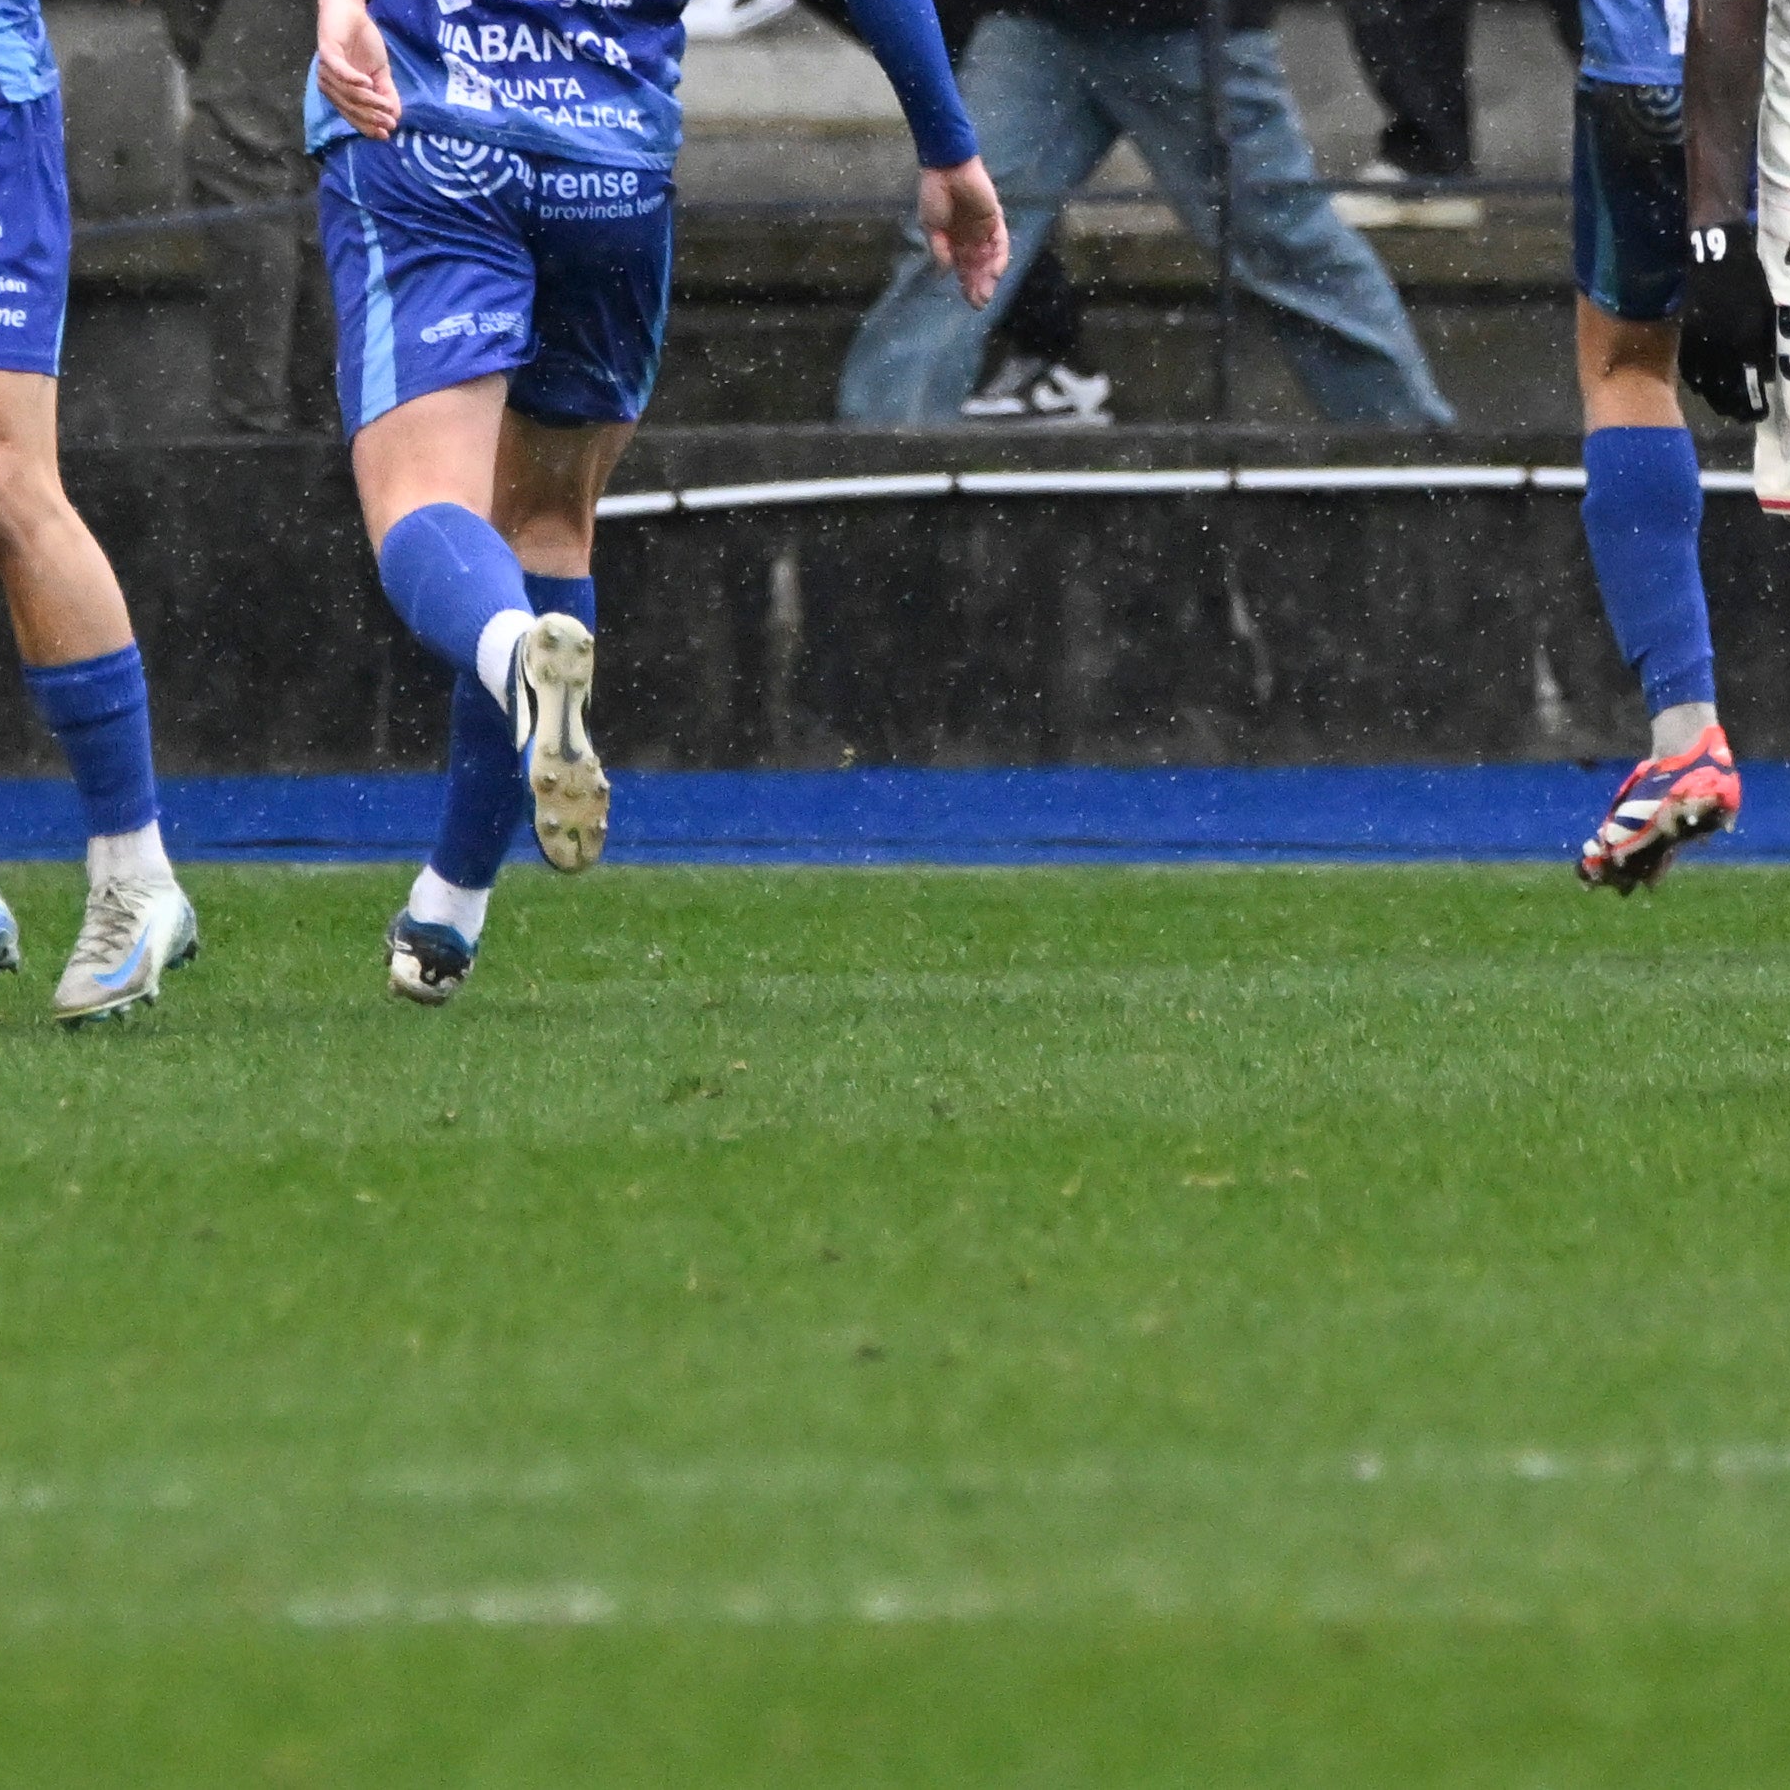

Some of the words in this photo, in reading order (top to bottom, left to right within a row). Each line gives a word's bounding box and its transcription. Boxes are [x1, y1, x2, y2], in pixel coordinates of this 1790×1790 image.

[451, 23, 632, 71] ABANCA
[532, 105, 644, 133] GALICIA
[1690, 228, 1727, 263] 19
